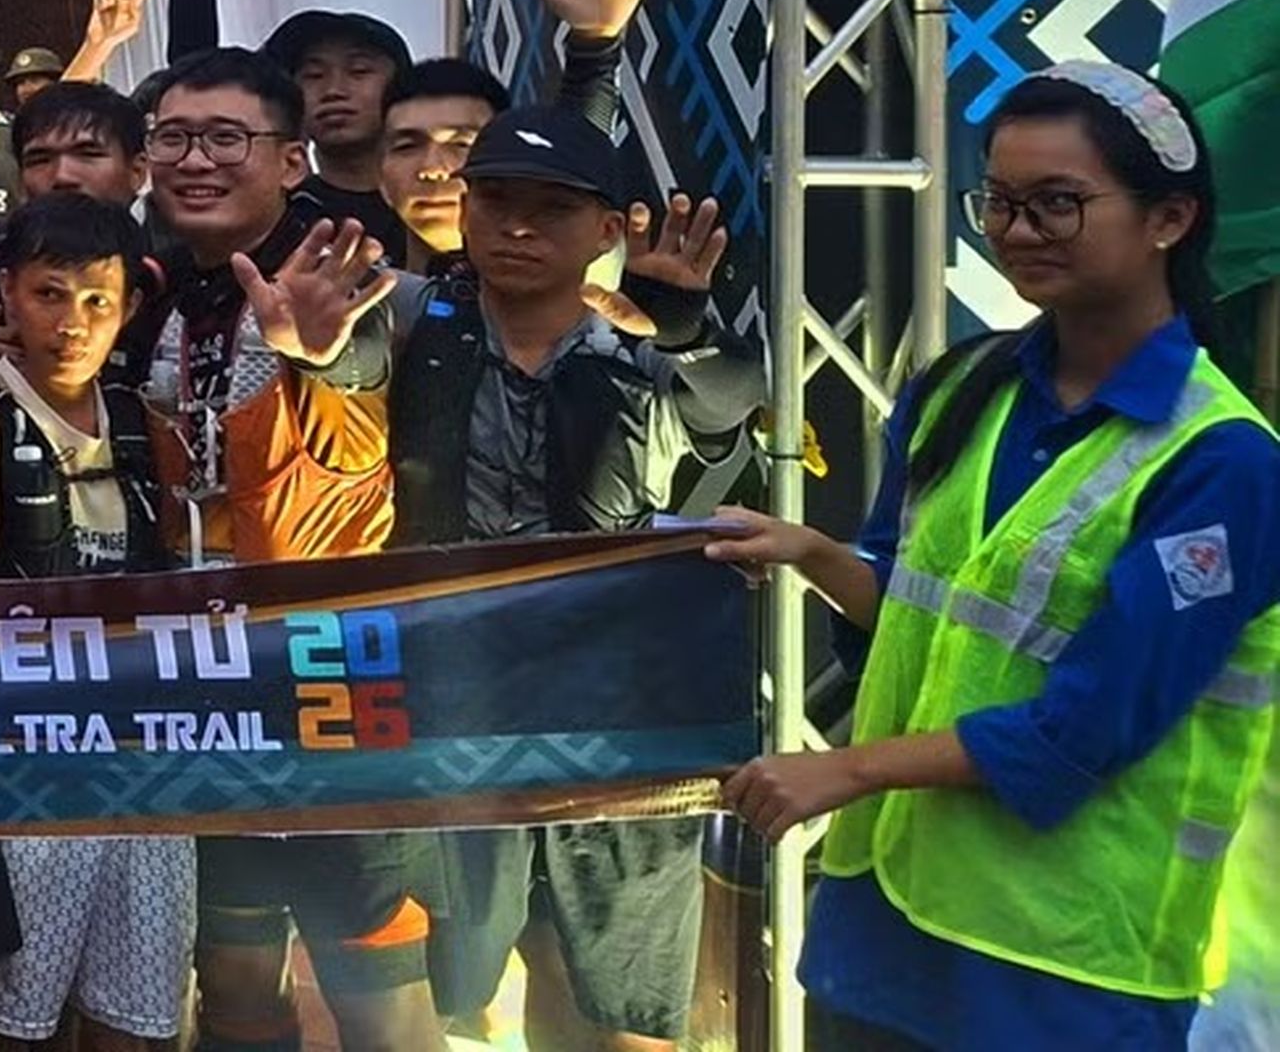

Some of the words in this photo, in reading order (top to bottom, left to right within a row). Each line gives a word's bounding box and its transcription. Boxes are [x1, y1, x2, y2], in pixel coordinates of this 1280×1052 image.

[135, 598, 252, 680] TỬ
[283, 608, 403, 679] 20
[133, 711, 282, 753] TRAIL
[294, 683, 412, 751] 26
